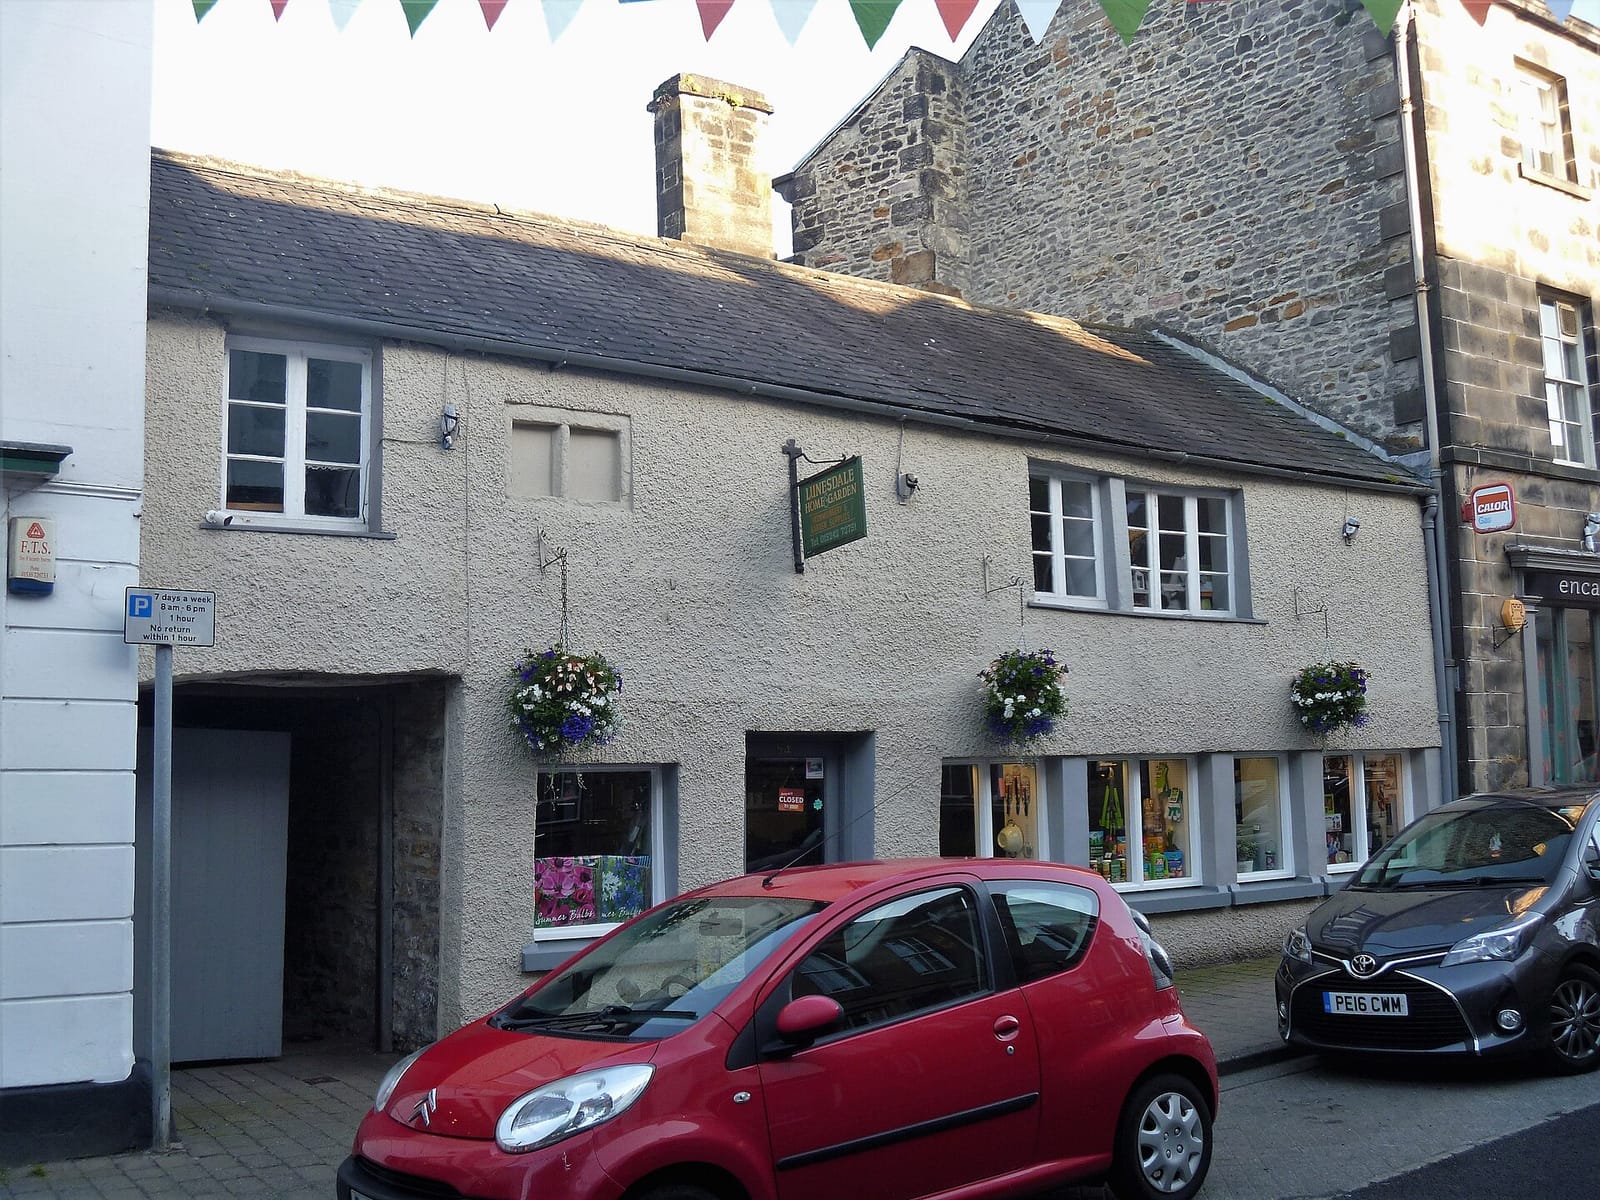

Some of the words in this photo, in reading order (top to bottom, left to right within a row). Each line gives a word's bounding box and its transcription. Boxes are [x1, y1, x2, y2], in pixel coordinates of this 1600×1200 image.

[805, 469, 854, 502] LUNESDALE
[804, 498, 824, 513] HOME
[828, 483, 857, 503] GARDEN
[1477, 500, 1509, 513] CALOR
[20, 540, 51, 554] F.T.S.
[1559, 579, 1600, 596] enca
[161, 594, 180, 602] days
[536, 912, 567, 925] Summer
[569, 908, 595, 921] Bulbs
[1335, 995, 1368, 1012] PE16
[1370, 996, 1402, 1013] CWM
